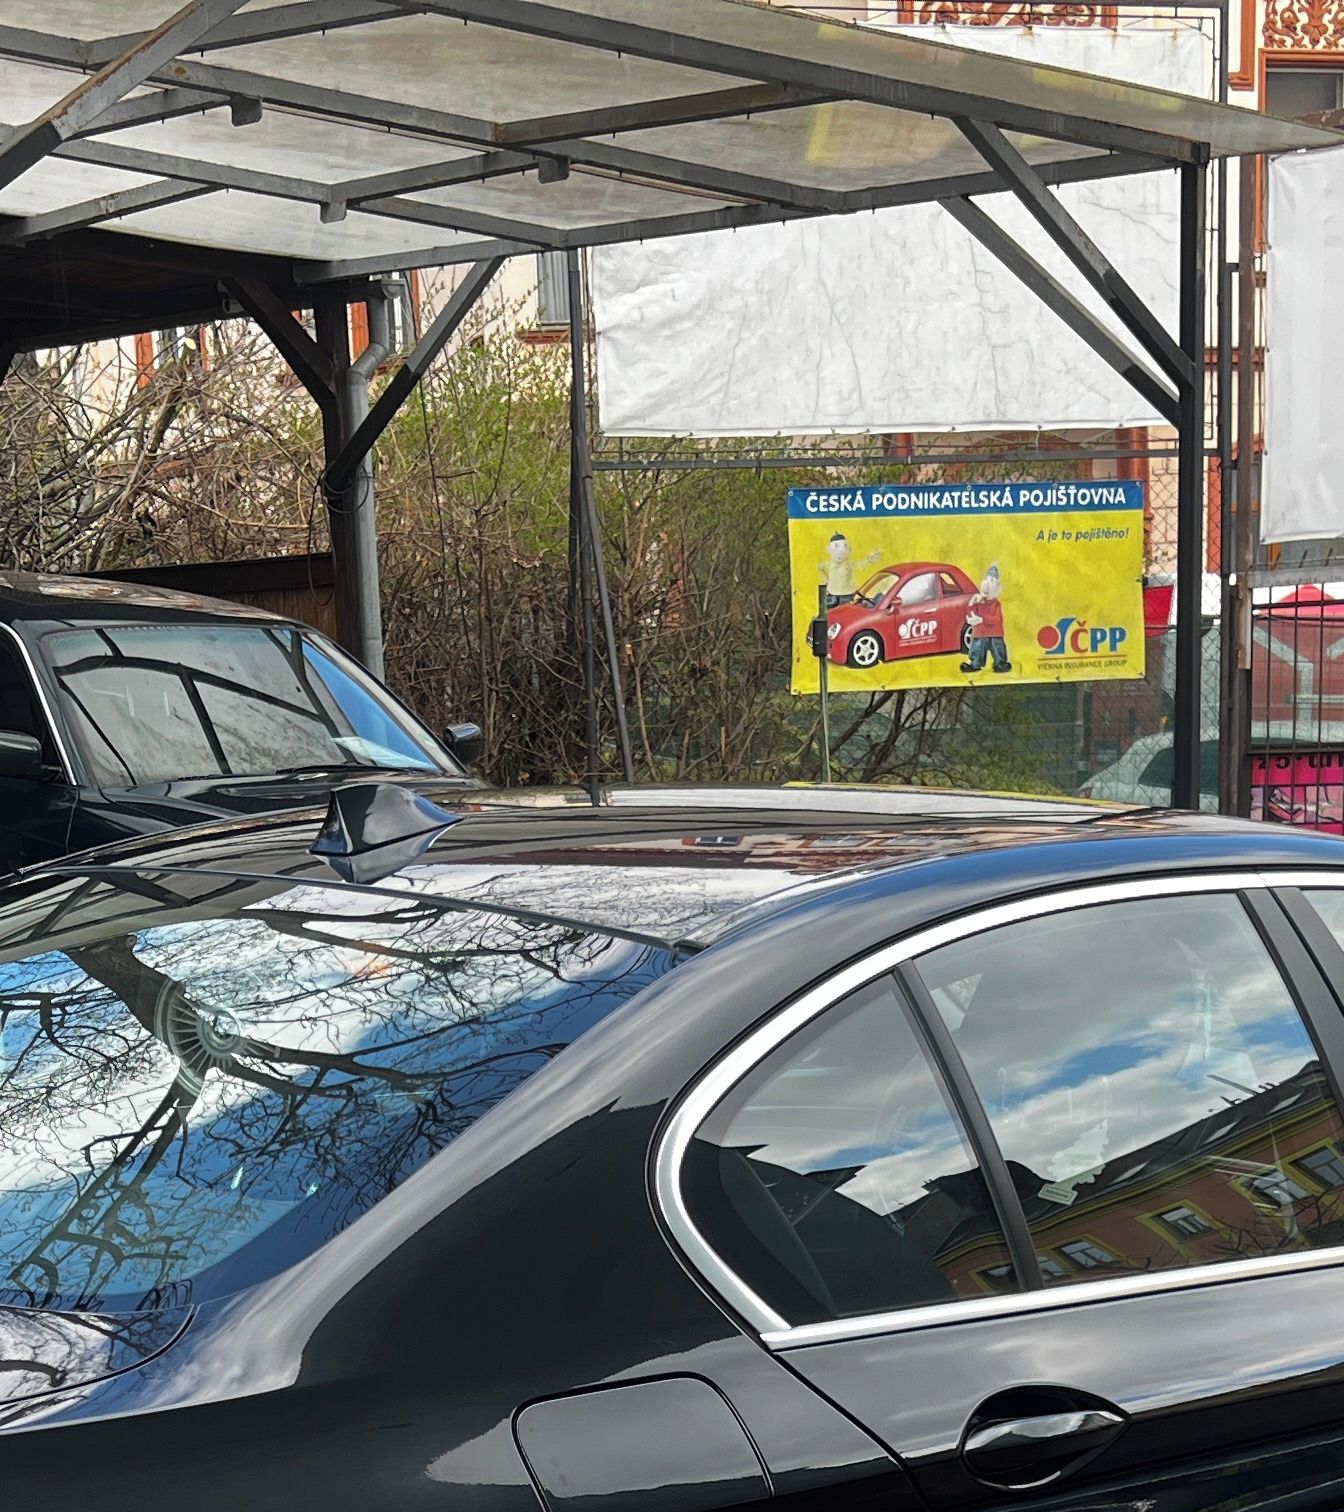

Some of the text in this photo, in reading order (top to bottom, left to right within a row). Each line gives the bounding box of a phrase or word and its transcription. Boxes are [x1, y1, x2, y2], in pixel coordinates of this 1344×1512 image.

[806, 485, 1126, 512] ČESKÁ PODNIKATELSKÁ POJIŠŤOVNA
[1036, 527, 1130, 543] A je to pojištěno!
[912, 618, 938, 638] ČPP
[1070, 620, 1127, 653] ČPP
